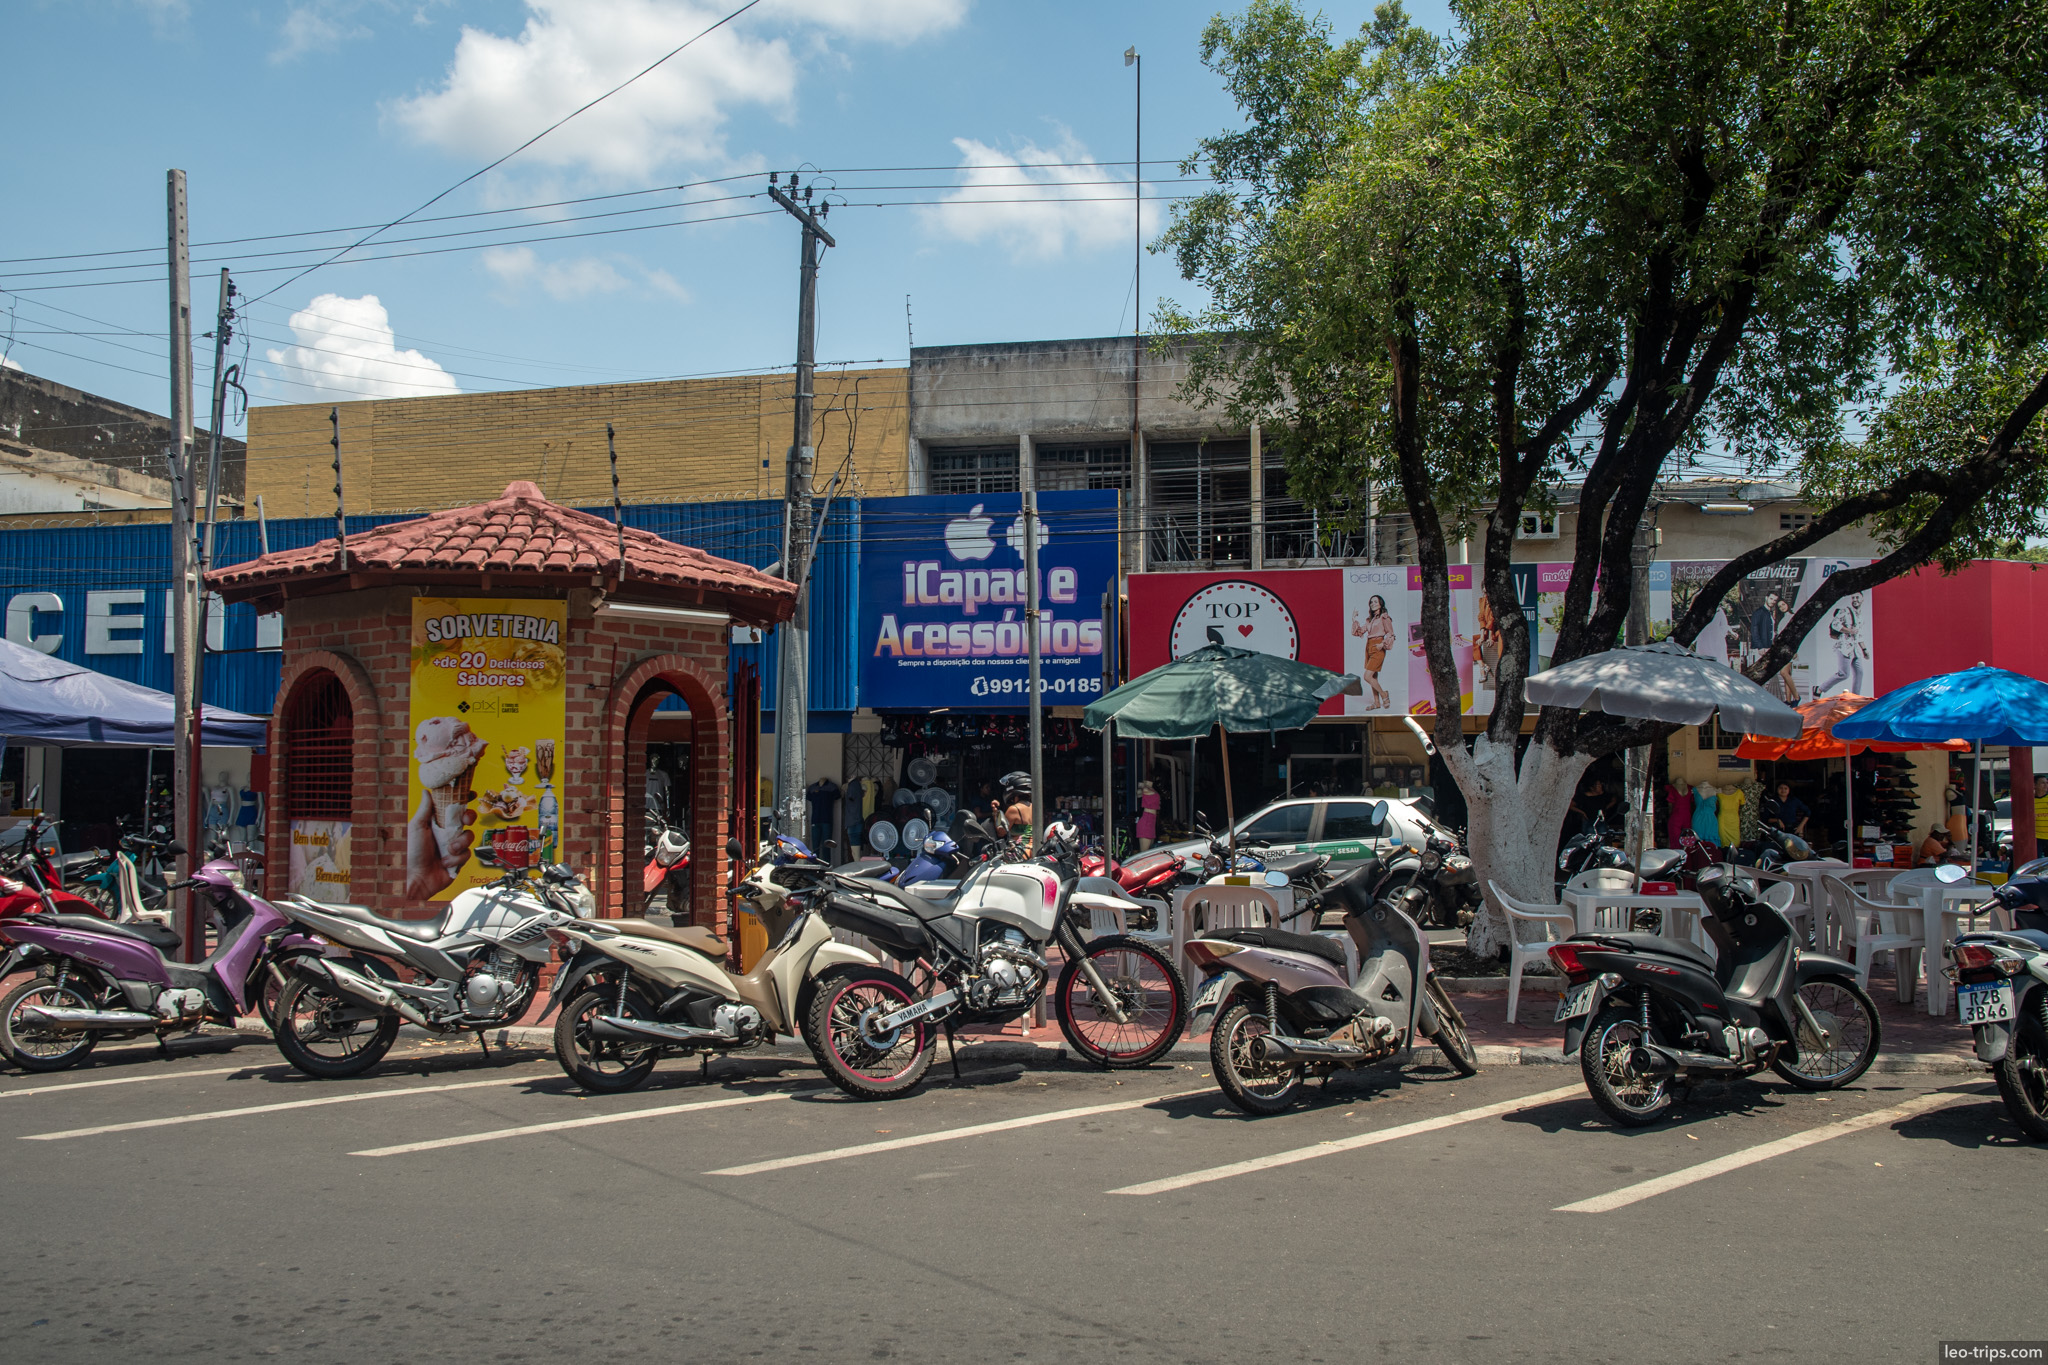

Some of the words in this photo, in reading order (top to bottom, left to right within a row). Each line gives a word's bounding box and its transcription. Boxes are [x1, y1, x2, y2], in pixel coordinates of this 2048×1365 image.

[1349, 571, 1380, 583] beira
[1382, 570, 1397, 582] rio
[904, 562, 1038, 613] iCapas
[1049, 568, 1076, 602] e
[1205, 602, 1260, 618] TOP
[425, 613, 559, 644] SORVETERIA
[873, 609, 1102, 657] Acessórios
[459, 651, 487, 669] 20
[489, 658, 545, 670] Deliciosos
[898, 659, 925, 668] Sempre
[933, 658, 970, 667] disposição
[972, 658, 986, 666] dos
[1015, 657, 1044, 665] clies
[1052, 657, 1081, 666] amigos!
[457, 671, 525, 687] Sabores
[1337, 847, 1359, 855] SESAU
[1969, 989, 2001, 1006] RZB
[897, 1003, 928, 1021] YAMAHA
[1966, 1004, 2008, 1022] 3B46
